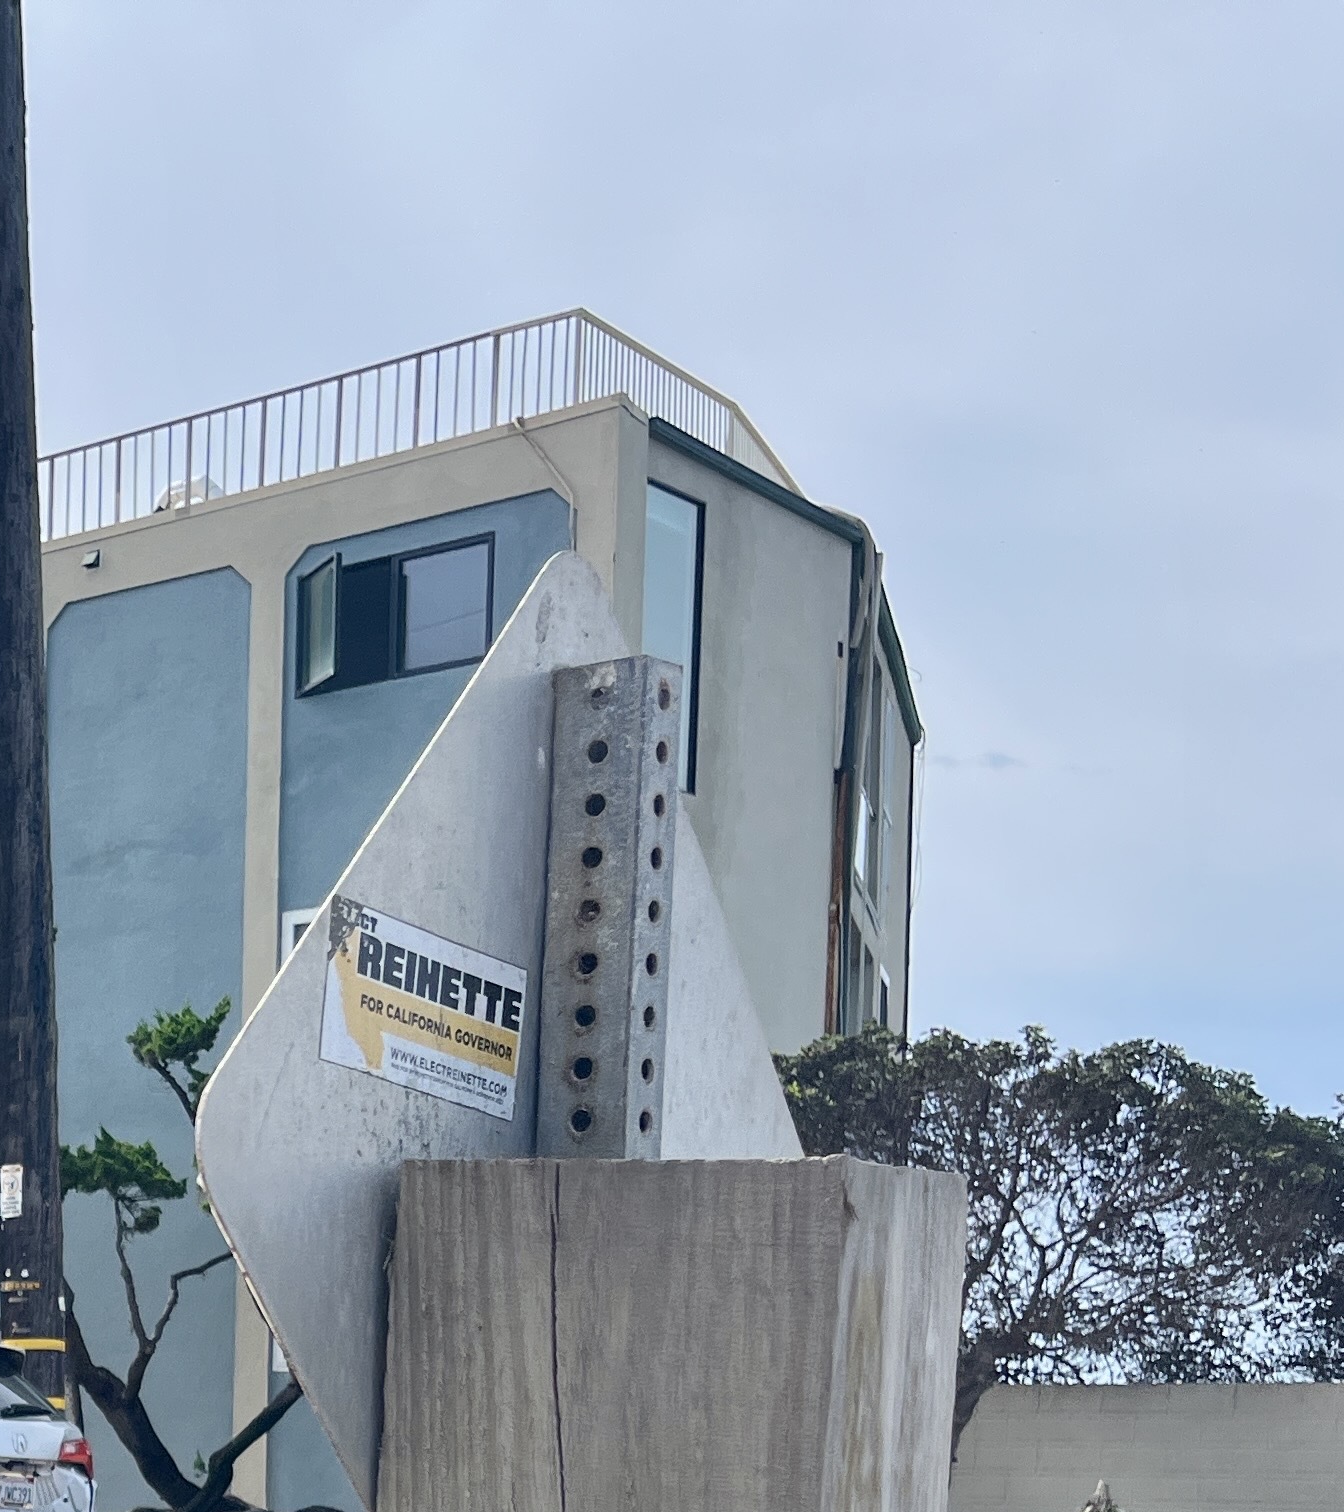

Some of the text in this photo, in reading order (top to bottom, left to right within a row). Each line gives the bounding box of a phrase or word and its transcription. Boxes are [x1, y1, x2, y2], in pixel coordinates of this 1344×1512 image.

[358, 932, 522, 1032] REINETTE
[360, 994, 513, 1061] FOR CALIFORNIA GOVERNOR
[390, 1047, 508, 1098] WWW.ELECTREINETTE.COM
